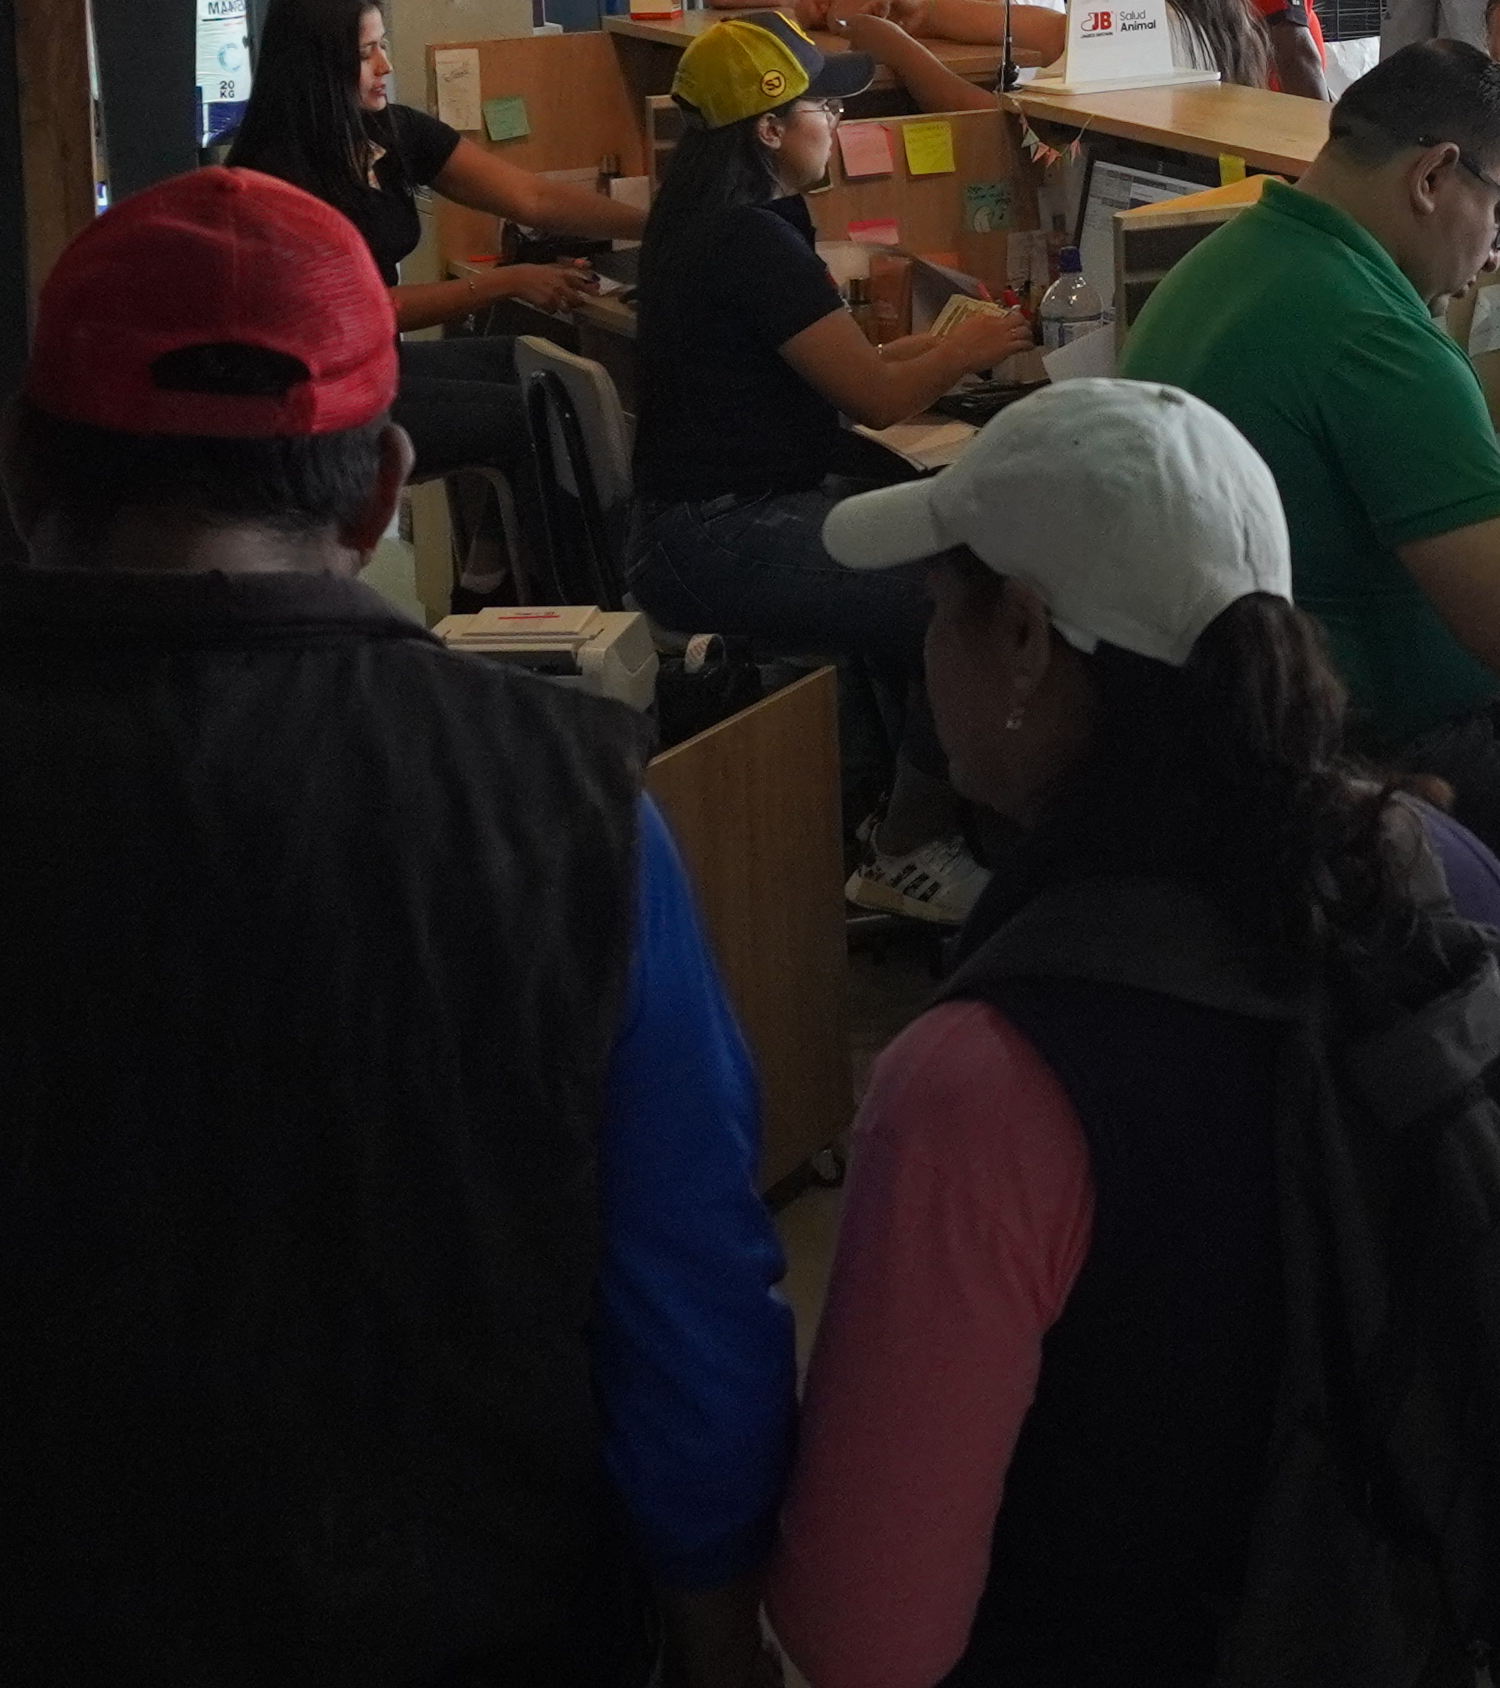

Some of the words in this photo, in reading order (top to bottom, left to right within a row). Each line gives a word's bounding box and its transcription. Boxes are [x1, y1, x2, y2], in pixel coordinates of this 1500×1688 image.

[1120, 10, 1146, 22] Salud
[1120, 20, 1157, 32] Animal
[219, 80, 235, 90] 20
[219, 90, 236, 99] KG
